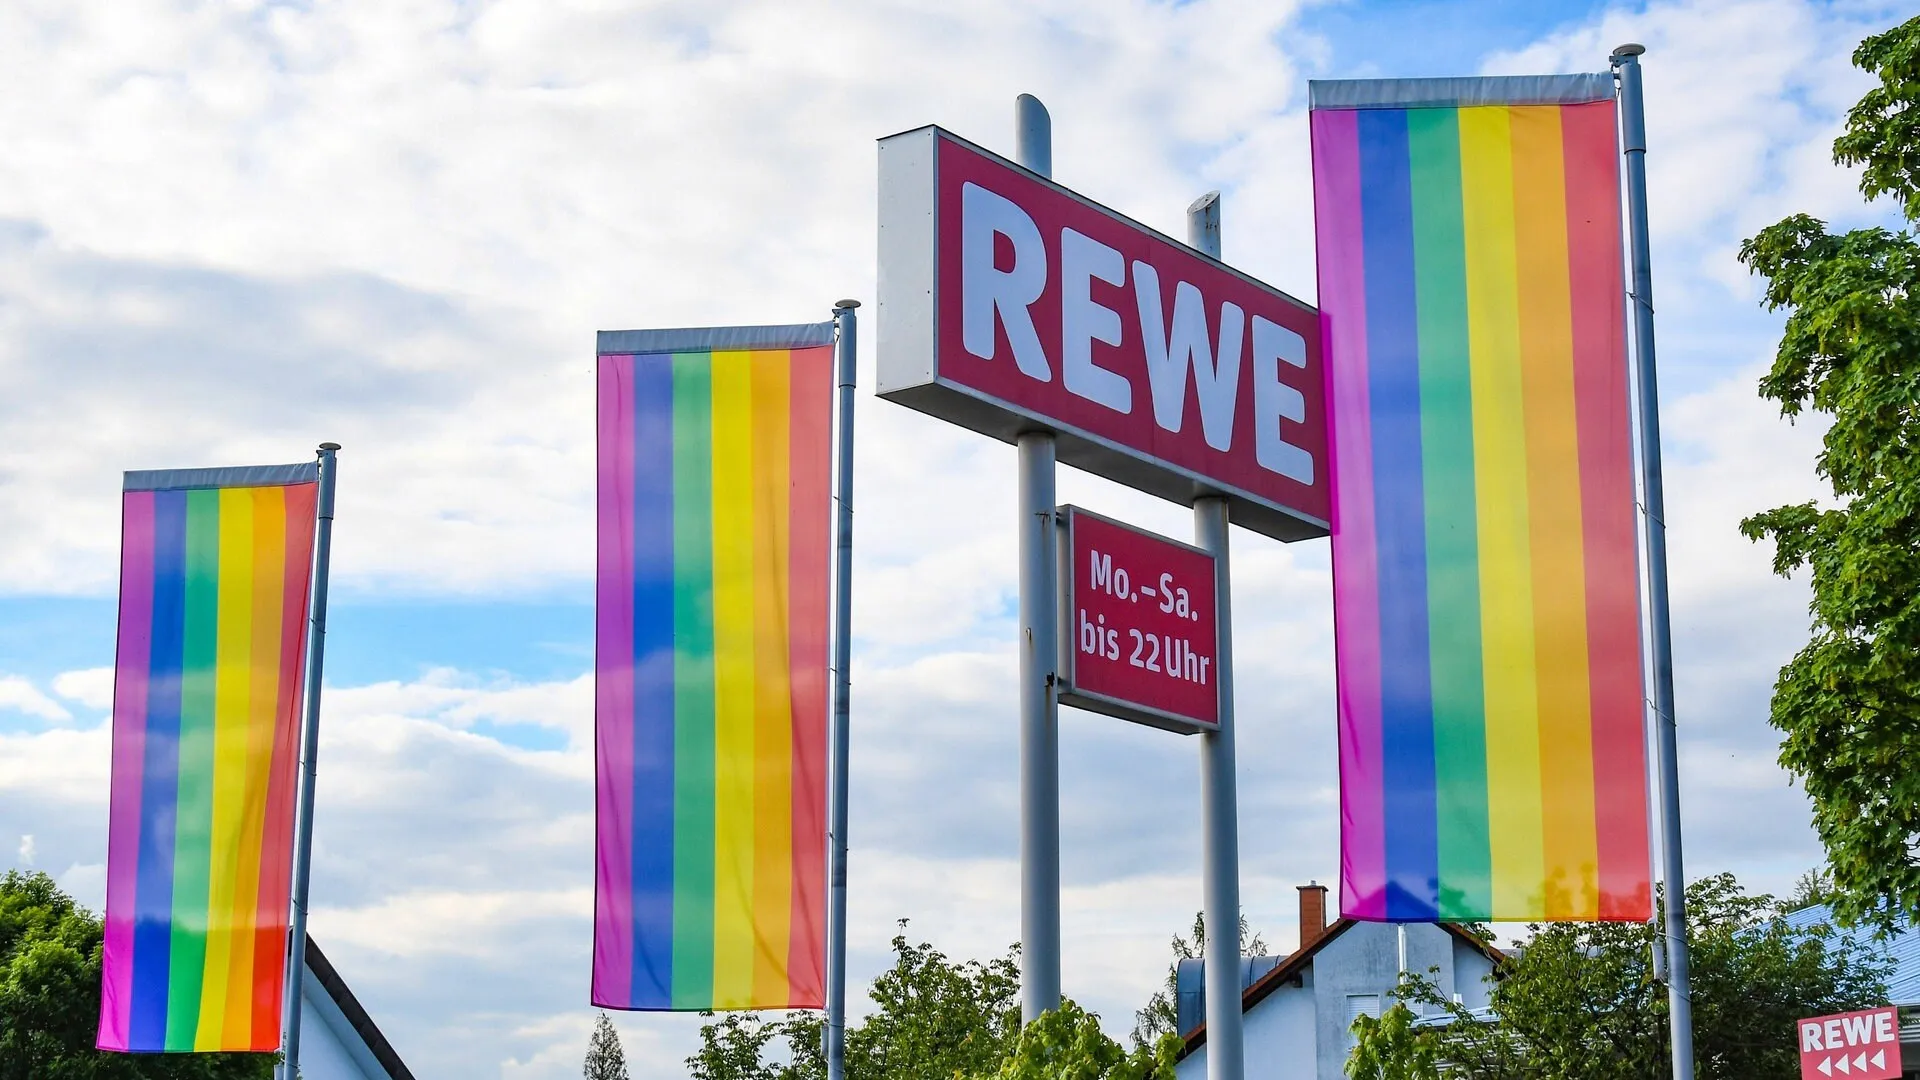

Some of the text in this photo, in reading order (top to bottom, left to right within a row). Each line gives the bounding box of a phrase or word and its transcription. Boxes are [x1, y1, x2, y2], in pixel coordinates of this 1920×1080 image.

[962, 181, 1315, 486] REWE
[1080, 608, 1120, 661] bis
[1801, 1012, 1895, 1053] REWE
